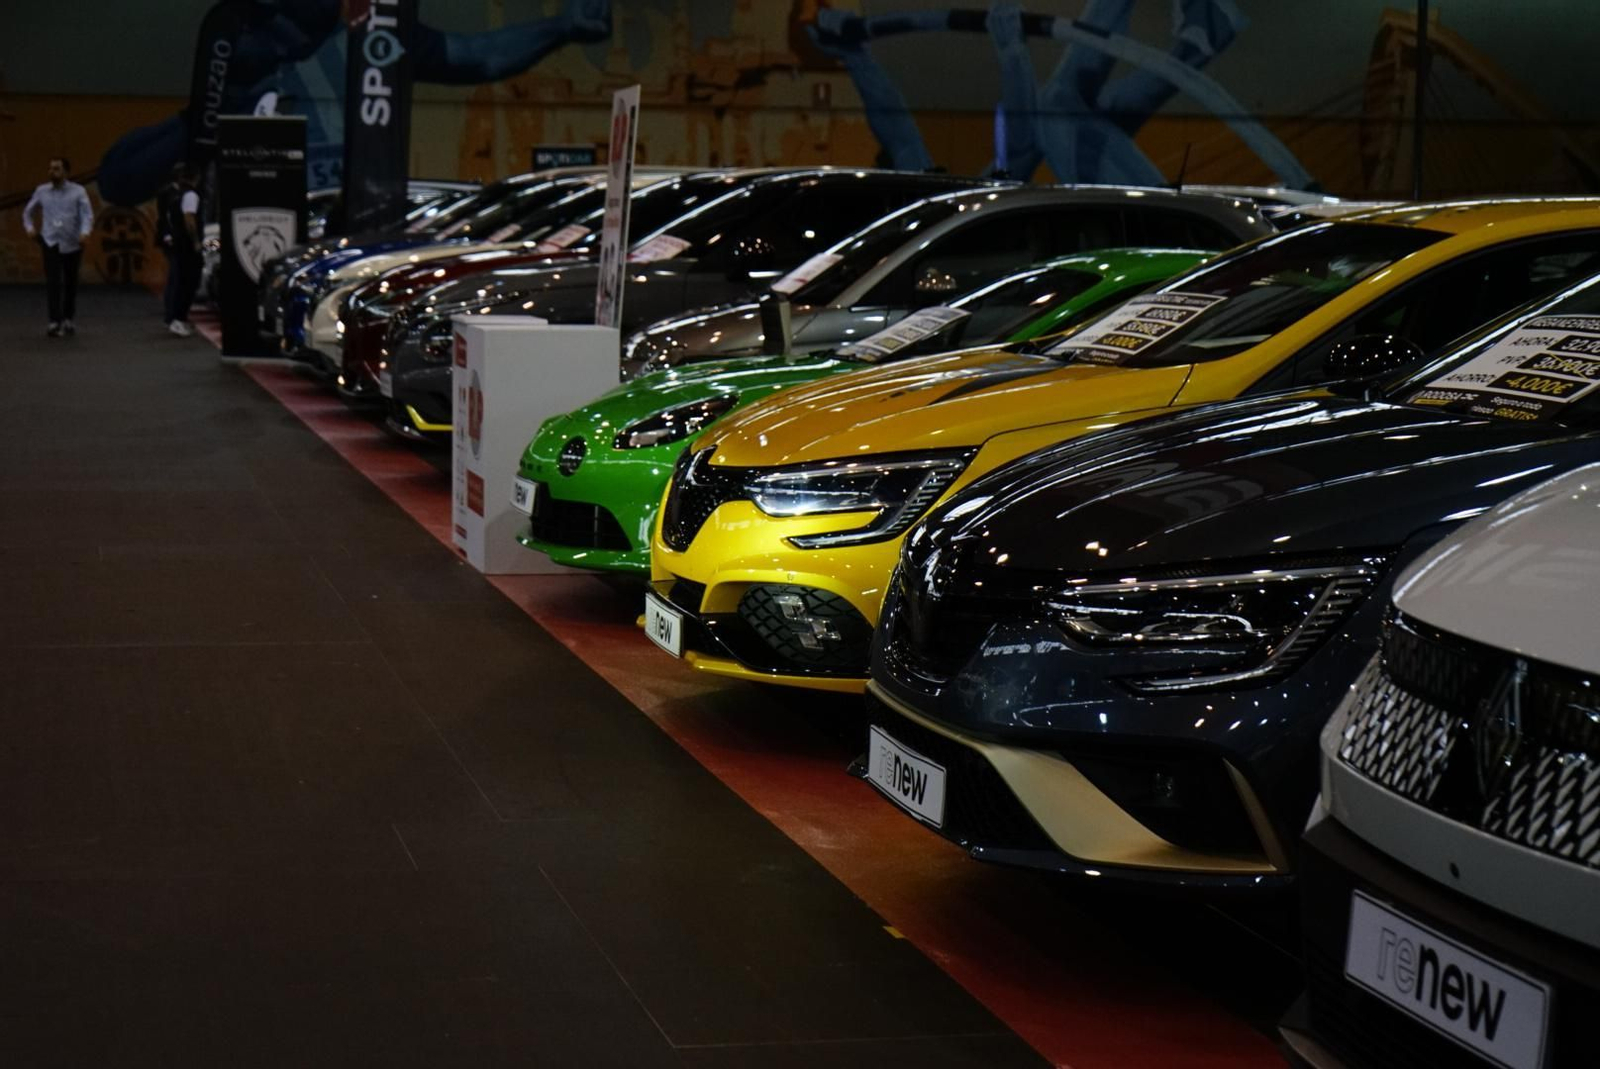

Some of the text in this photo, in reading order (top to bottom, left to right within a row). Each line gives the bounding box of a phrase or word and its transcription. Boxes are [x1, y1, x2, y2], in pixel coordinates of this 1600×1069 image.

[195, 39, 233, 146] Louzao
[1505, 375, 1575, 395] -4.000€
[879, 745, 927, 806] renew
[1377, 926, 1507, 1042] renew
